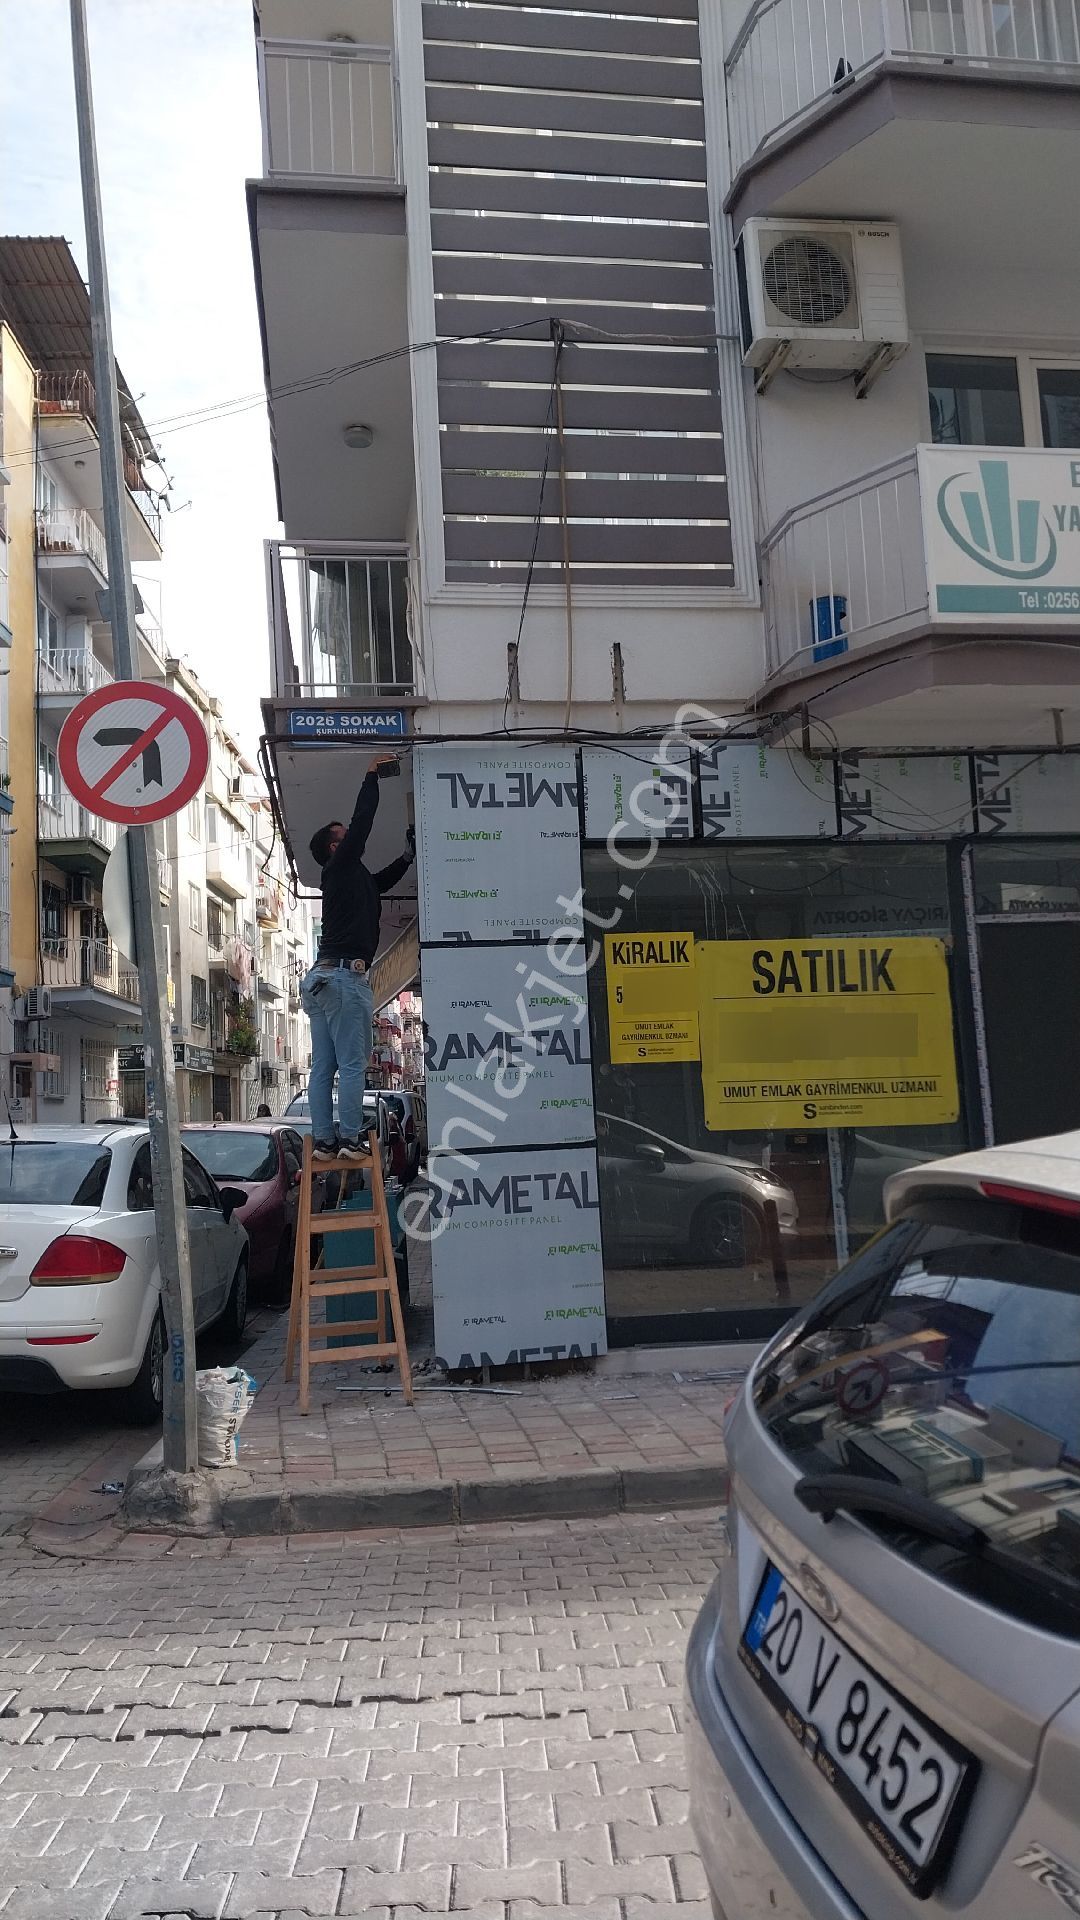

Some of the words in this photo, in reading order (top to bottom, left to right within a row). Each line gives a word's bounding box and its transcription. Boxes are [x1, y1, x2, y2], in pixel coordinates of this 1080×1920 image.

[1018, 591, 1040, 608] Tel
[295, 715, 335, 726] 2026
[340, 715, 398, 726] SOKAK
[477, 761, 509, 769] PANEL
[512, 761, 571, 769] COMPOSITE
[519, 917, 579, 926] COMPOSITE
[752, 948, 896, 995] SATILIK
[653, 1022, 674, 1030] EMLAK
[459, 1072, 519, 1082] COMPOSITE
[524, 1070, 555, 1079] PANEL
[723, 1085, 758, 1099] UMUT
[761, 1083, 802, 1097] EMLAK
[805, 1080, 888, 1096] GAYRİMENKUL
[890, 1080, 937, 1094] UZMANI
[464, 1217, 526, 1229] COMPOSITE
[530, 1215, 562, 1225] PANEL
[761, 1591, 802, 1676] 20
[806, 1635, 841, 1715] V
[836, 1679, 945, 1851] 8452
